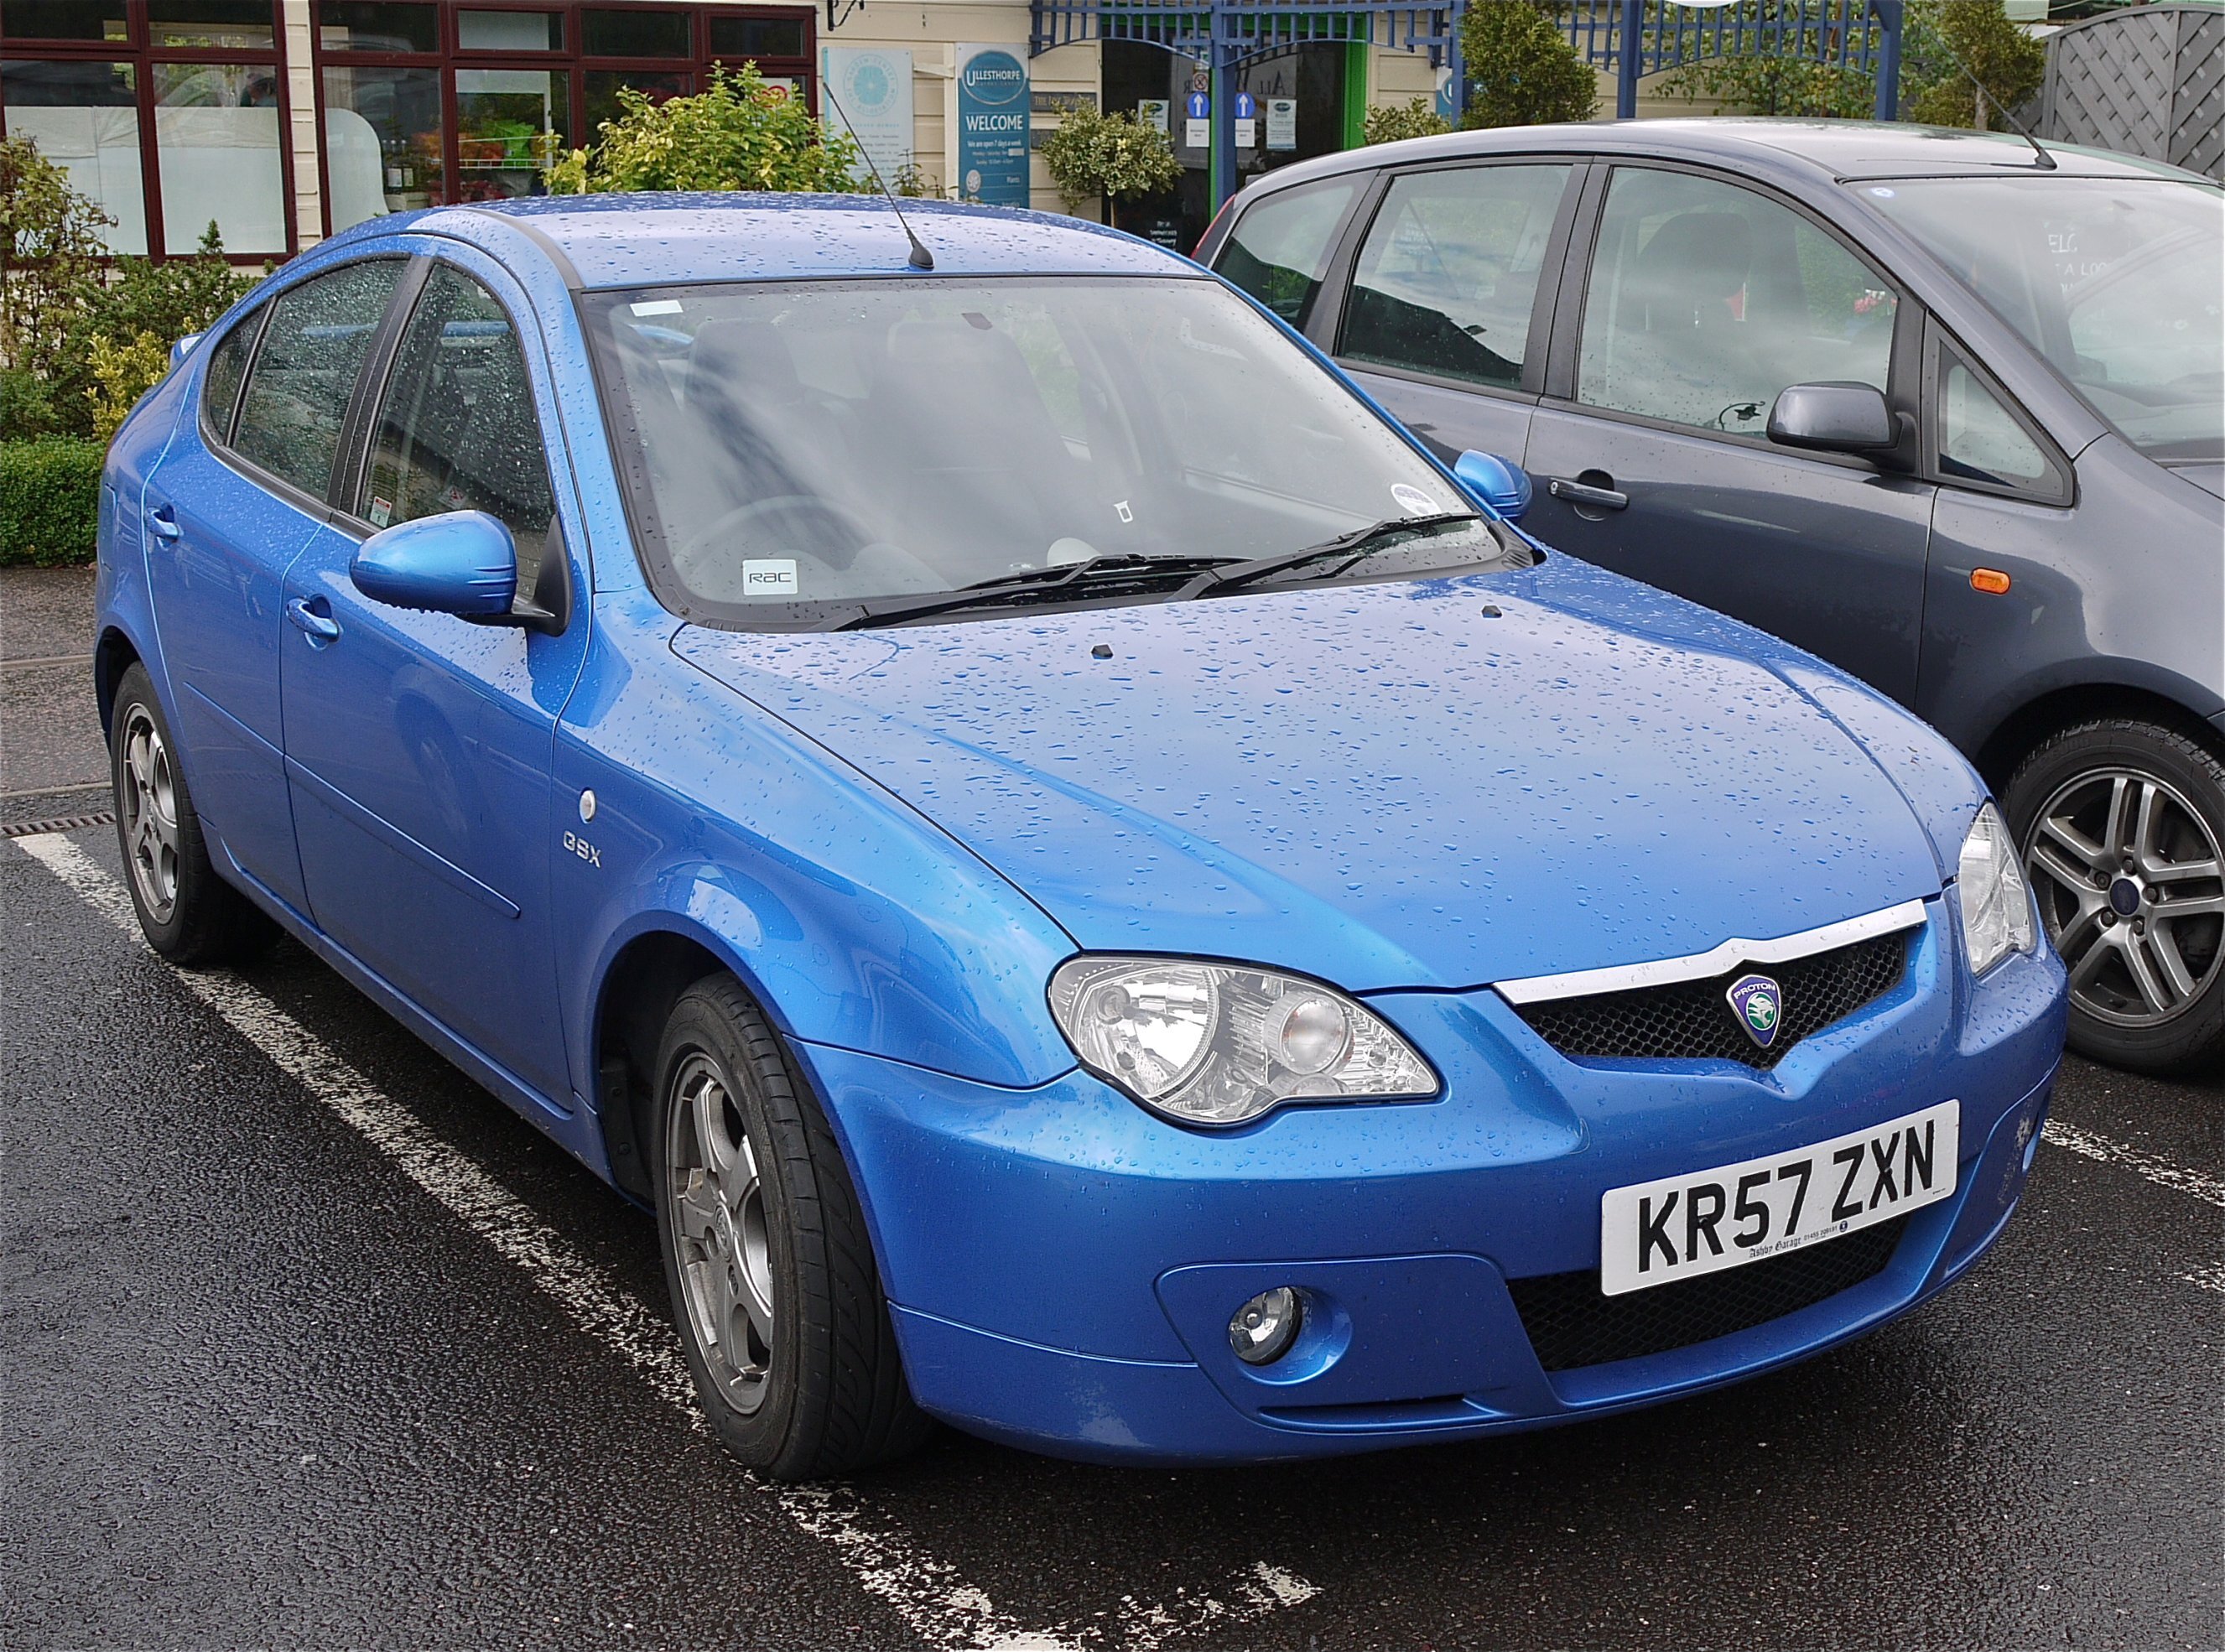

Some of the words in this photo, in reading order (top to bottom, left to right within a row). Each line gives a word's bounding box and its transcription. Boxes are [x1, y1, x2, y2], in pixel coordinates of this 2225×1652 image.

[966, 70, 1021, 86] ULLESTHORPE
[966, 115, 1023, 132] WELCOME
[564, 830, 601, 868] GSX
[1733, 983, 1775, 1000] PROTON
[1638, 1159, 1813, 1273] KR57
[1831, 1120, 1934, 1223] ZXN
[1749, 1244, 1773, 1258] Ashby
[1775, 1237, 1801, 1252] Garage
